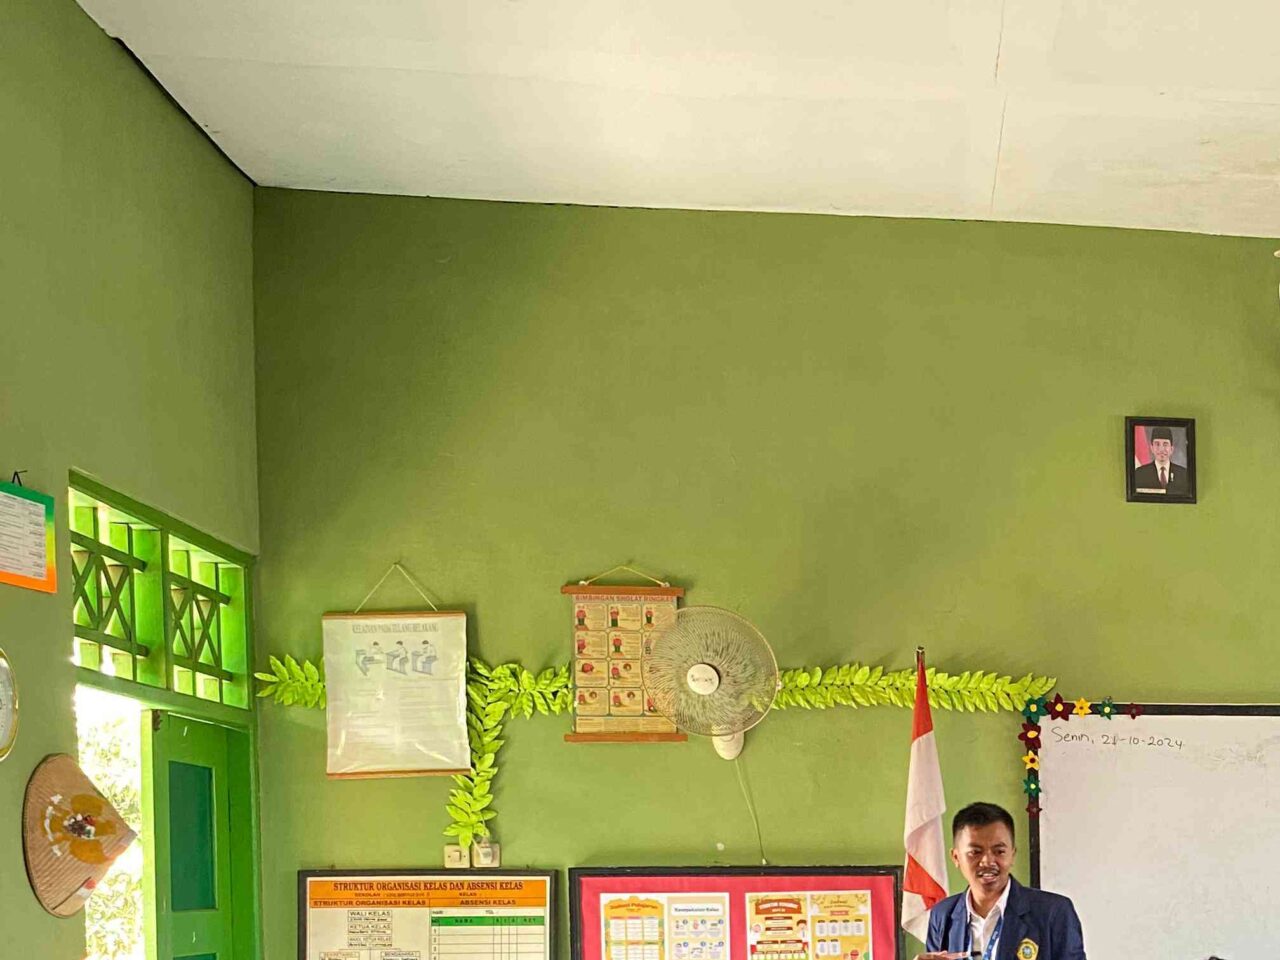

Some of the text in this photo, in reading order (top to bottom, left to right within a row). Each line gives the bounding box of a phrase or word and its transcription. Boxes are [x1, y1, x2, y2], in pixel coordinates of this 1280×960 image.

[333, 881, 523, 891] STRUKTUR ORGANISASI KELAS DAN ABSENSI KELAS
